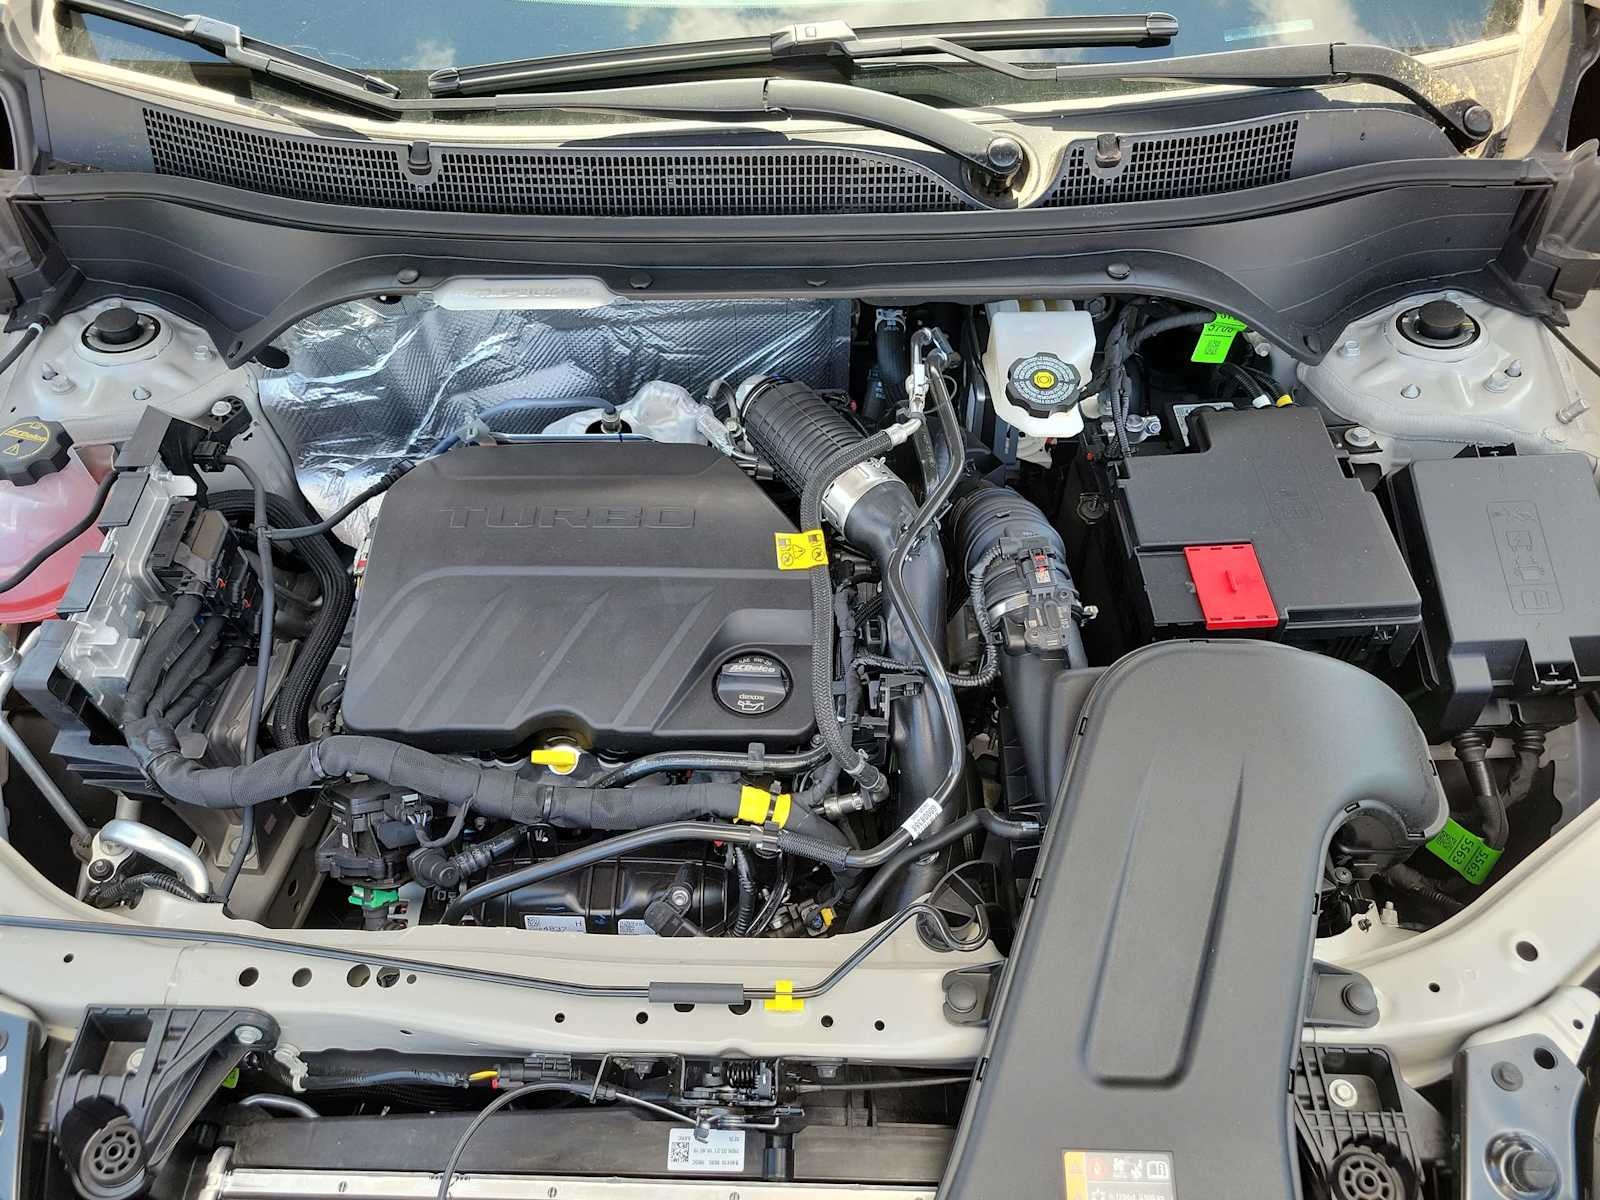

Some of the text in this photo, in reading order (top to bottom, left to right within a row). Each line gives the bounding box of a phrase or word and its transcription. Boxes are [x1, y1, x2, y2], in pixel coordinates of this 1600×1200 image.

[440, 505, 696, 529] TURBO
[728, 664, 776, 673] ACDelco
[1452, 838, 1474, 865] 5563
[1466, 849, 1489, 877] 5563
